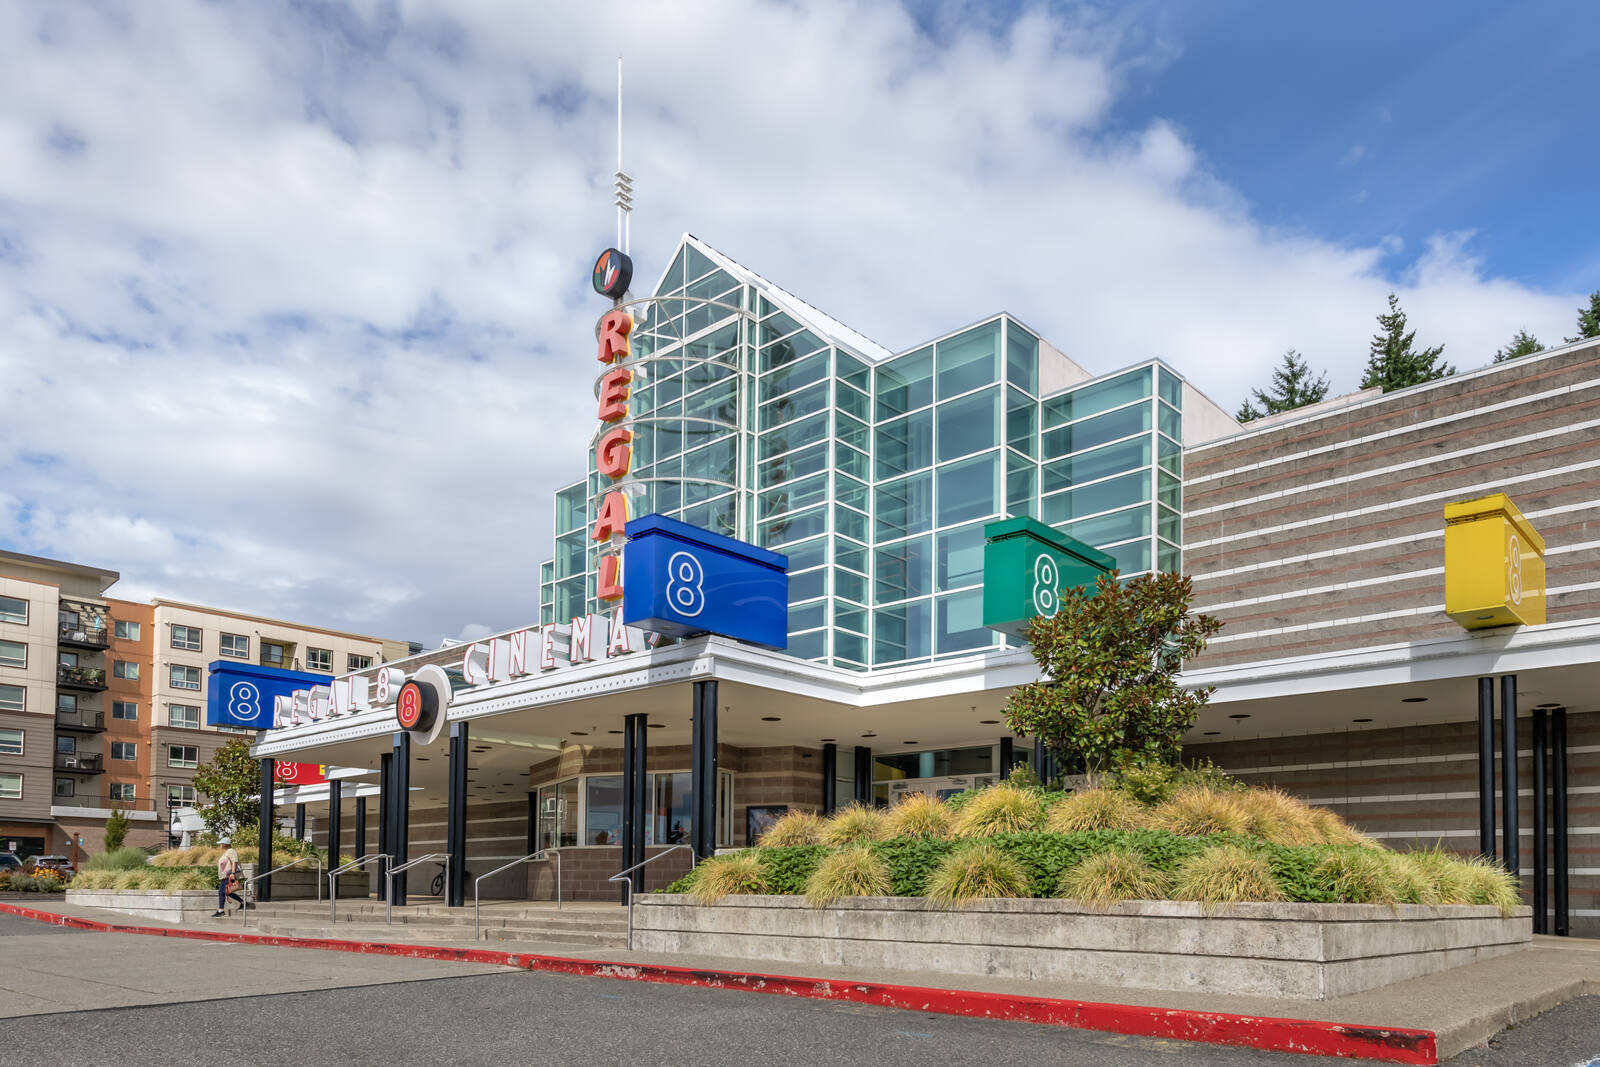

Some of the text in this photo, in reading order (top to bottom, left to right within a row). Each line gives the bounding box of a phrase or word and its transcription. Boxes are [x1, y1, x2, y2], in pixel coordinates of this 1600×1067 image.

[591, 310, 633, 604] REGAL
[666, 551, 705, 617] 8
[1033, 553, 1059, 619] 8
[1509, 535, 1522, 606] 8
[273, 605, 660, 728] REGAL 8 CINEMA
[229, 681, 261, 721] 8
[401, 688, 417, 722] 8
